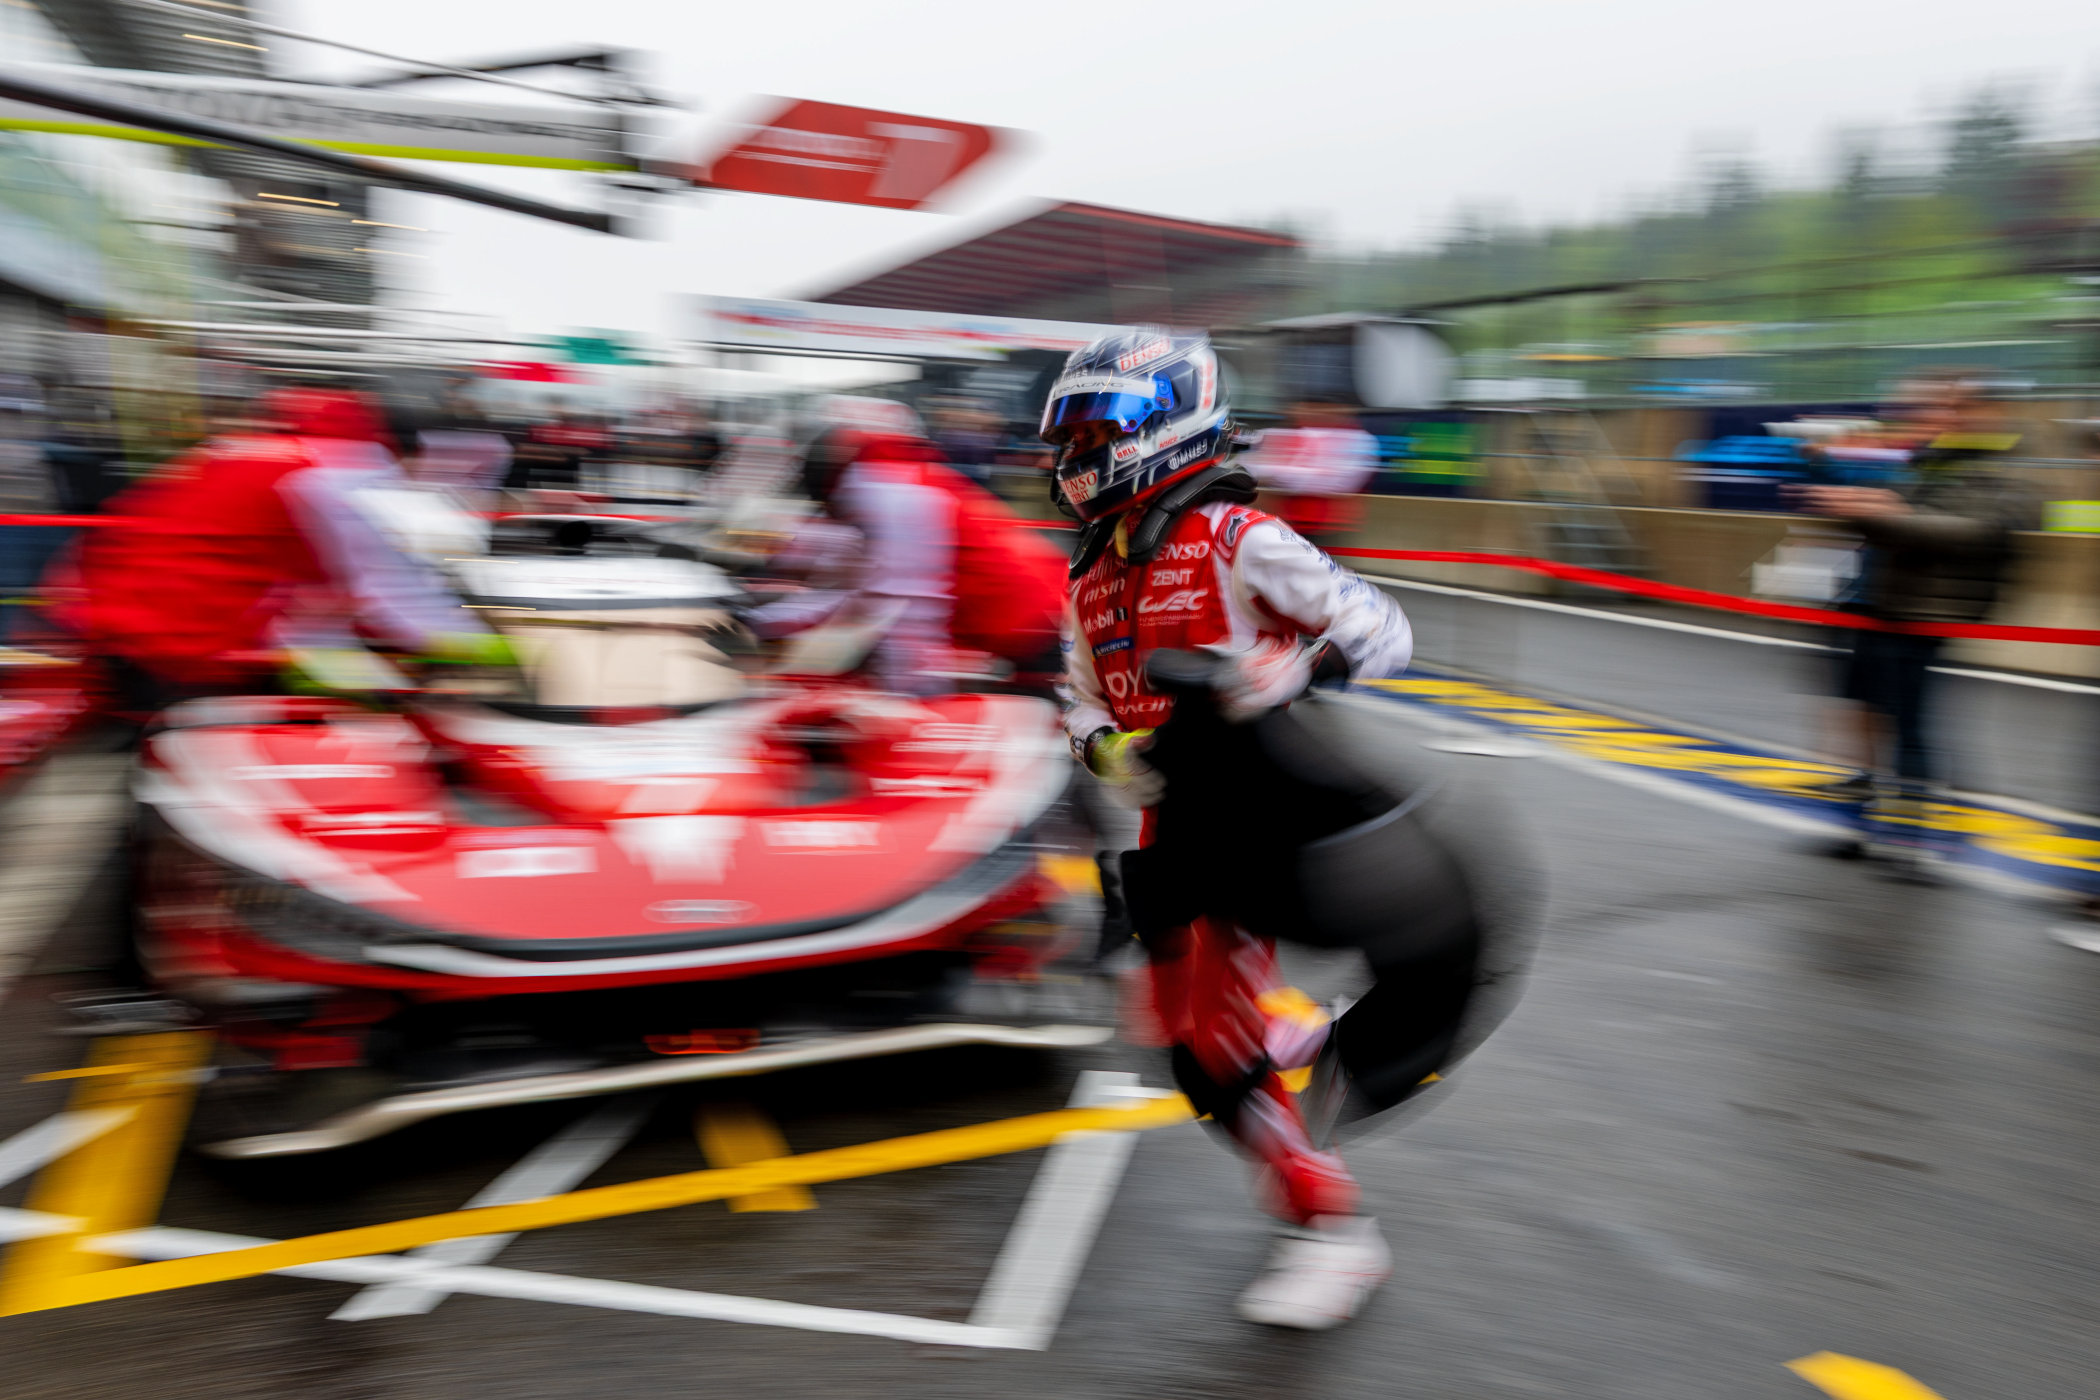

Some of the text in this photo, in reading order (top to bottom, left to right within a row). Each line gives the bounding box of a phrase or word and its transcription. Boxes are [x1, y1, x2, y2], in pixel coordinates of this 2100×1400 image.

[1063, 471, 1098, 493] ENSO
[1154, 540, 1210, 561] ENSO
[1152, 568, 1194, 587] ZENT
[1137, 588, 1209, 614] WEC
[1083, 608, 1115, 634] Mobil
[1117, 608, 1126, 621] 1
